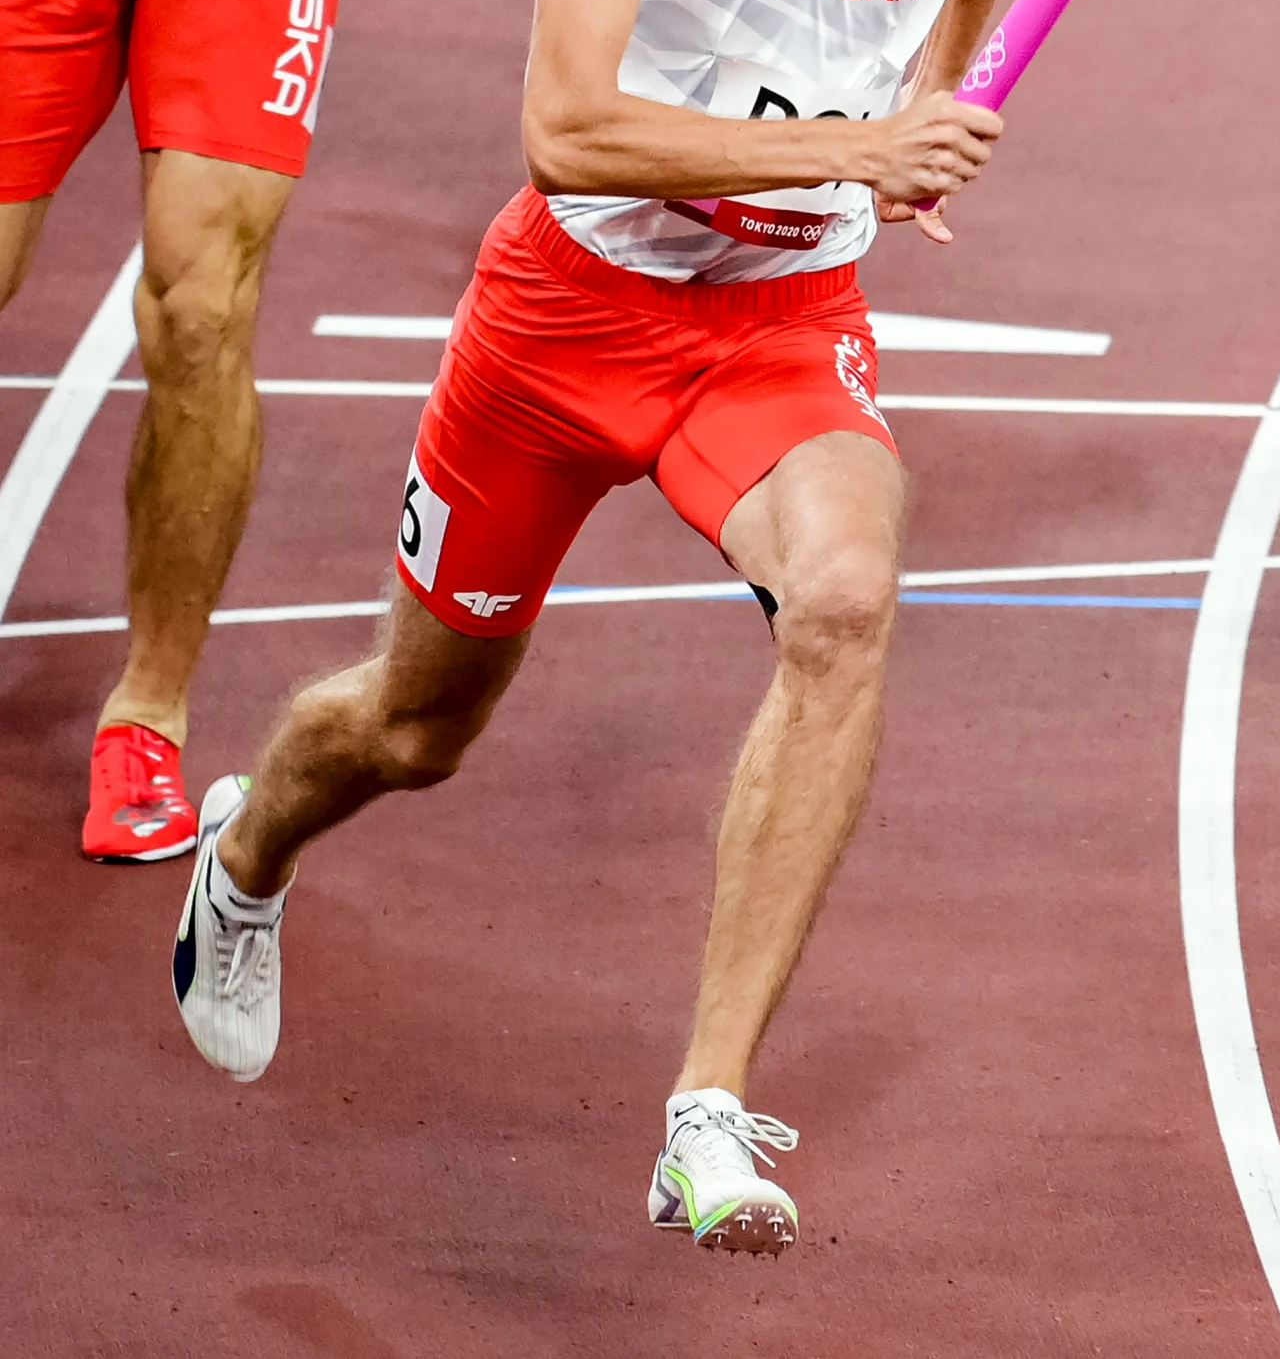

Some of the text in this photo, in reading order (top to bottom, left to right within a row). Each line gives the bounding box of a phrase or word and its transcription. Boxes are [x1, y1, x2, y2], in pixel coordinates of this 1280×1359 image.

[740, 215, 801, 238] TOKYO 2020
[400, 475, 422, 558] 6
